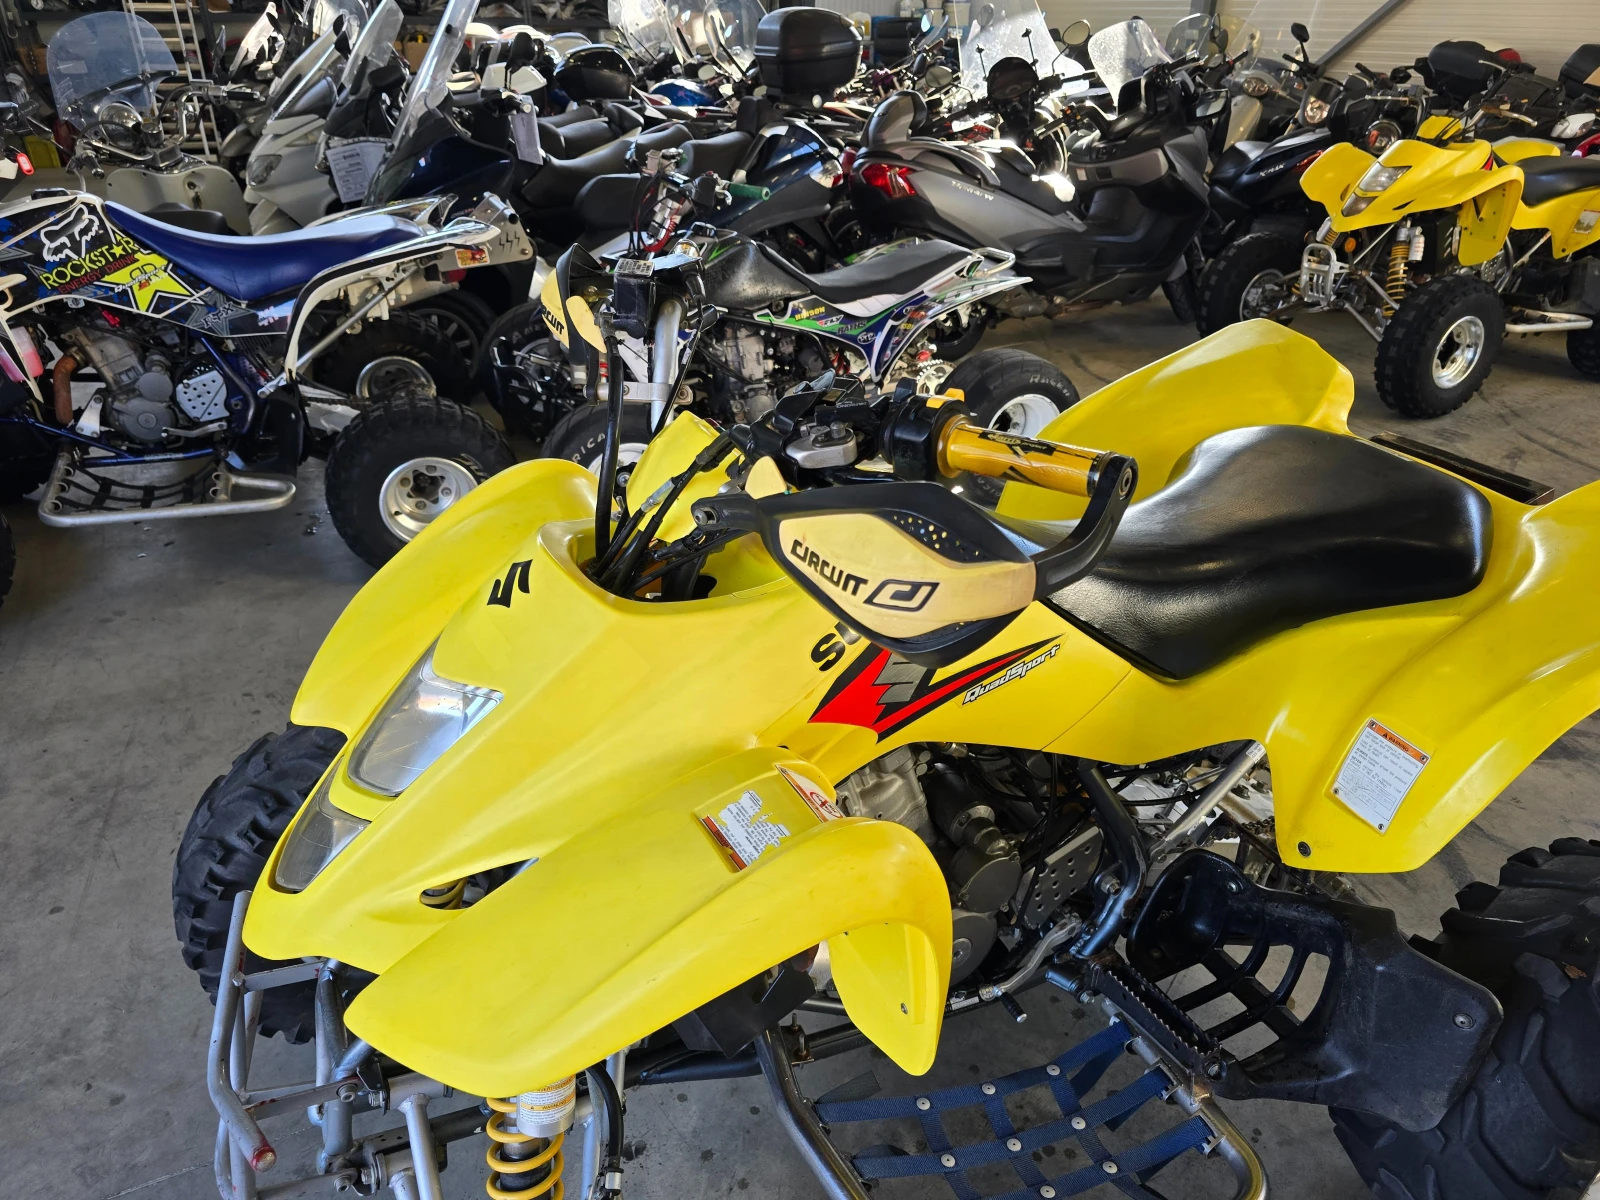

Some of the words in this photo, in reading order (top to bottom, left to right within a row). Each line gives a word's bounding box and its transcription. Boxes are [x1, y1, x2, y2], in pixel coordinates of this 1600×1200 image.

[58, 269, 101, 294] ENERGY
[105, 254, 138, 275] DRINK
[790, 539, 869, 597] CIRCUIT
[962, 643, 1061, 706] QuadSport
[1388, 737, 1410, 752] WARNING
